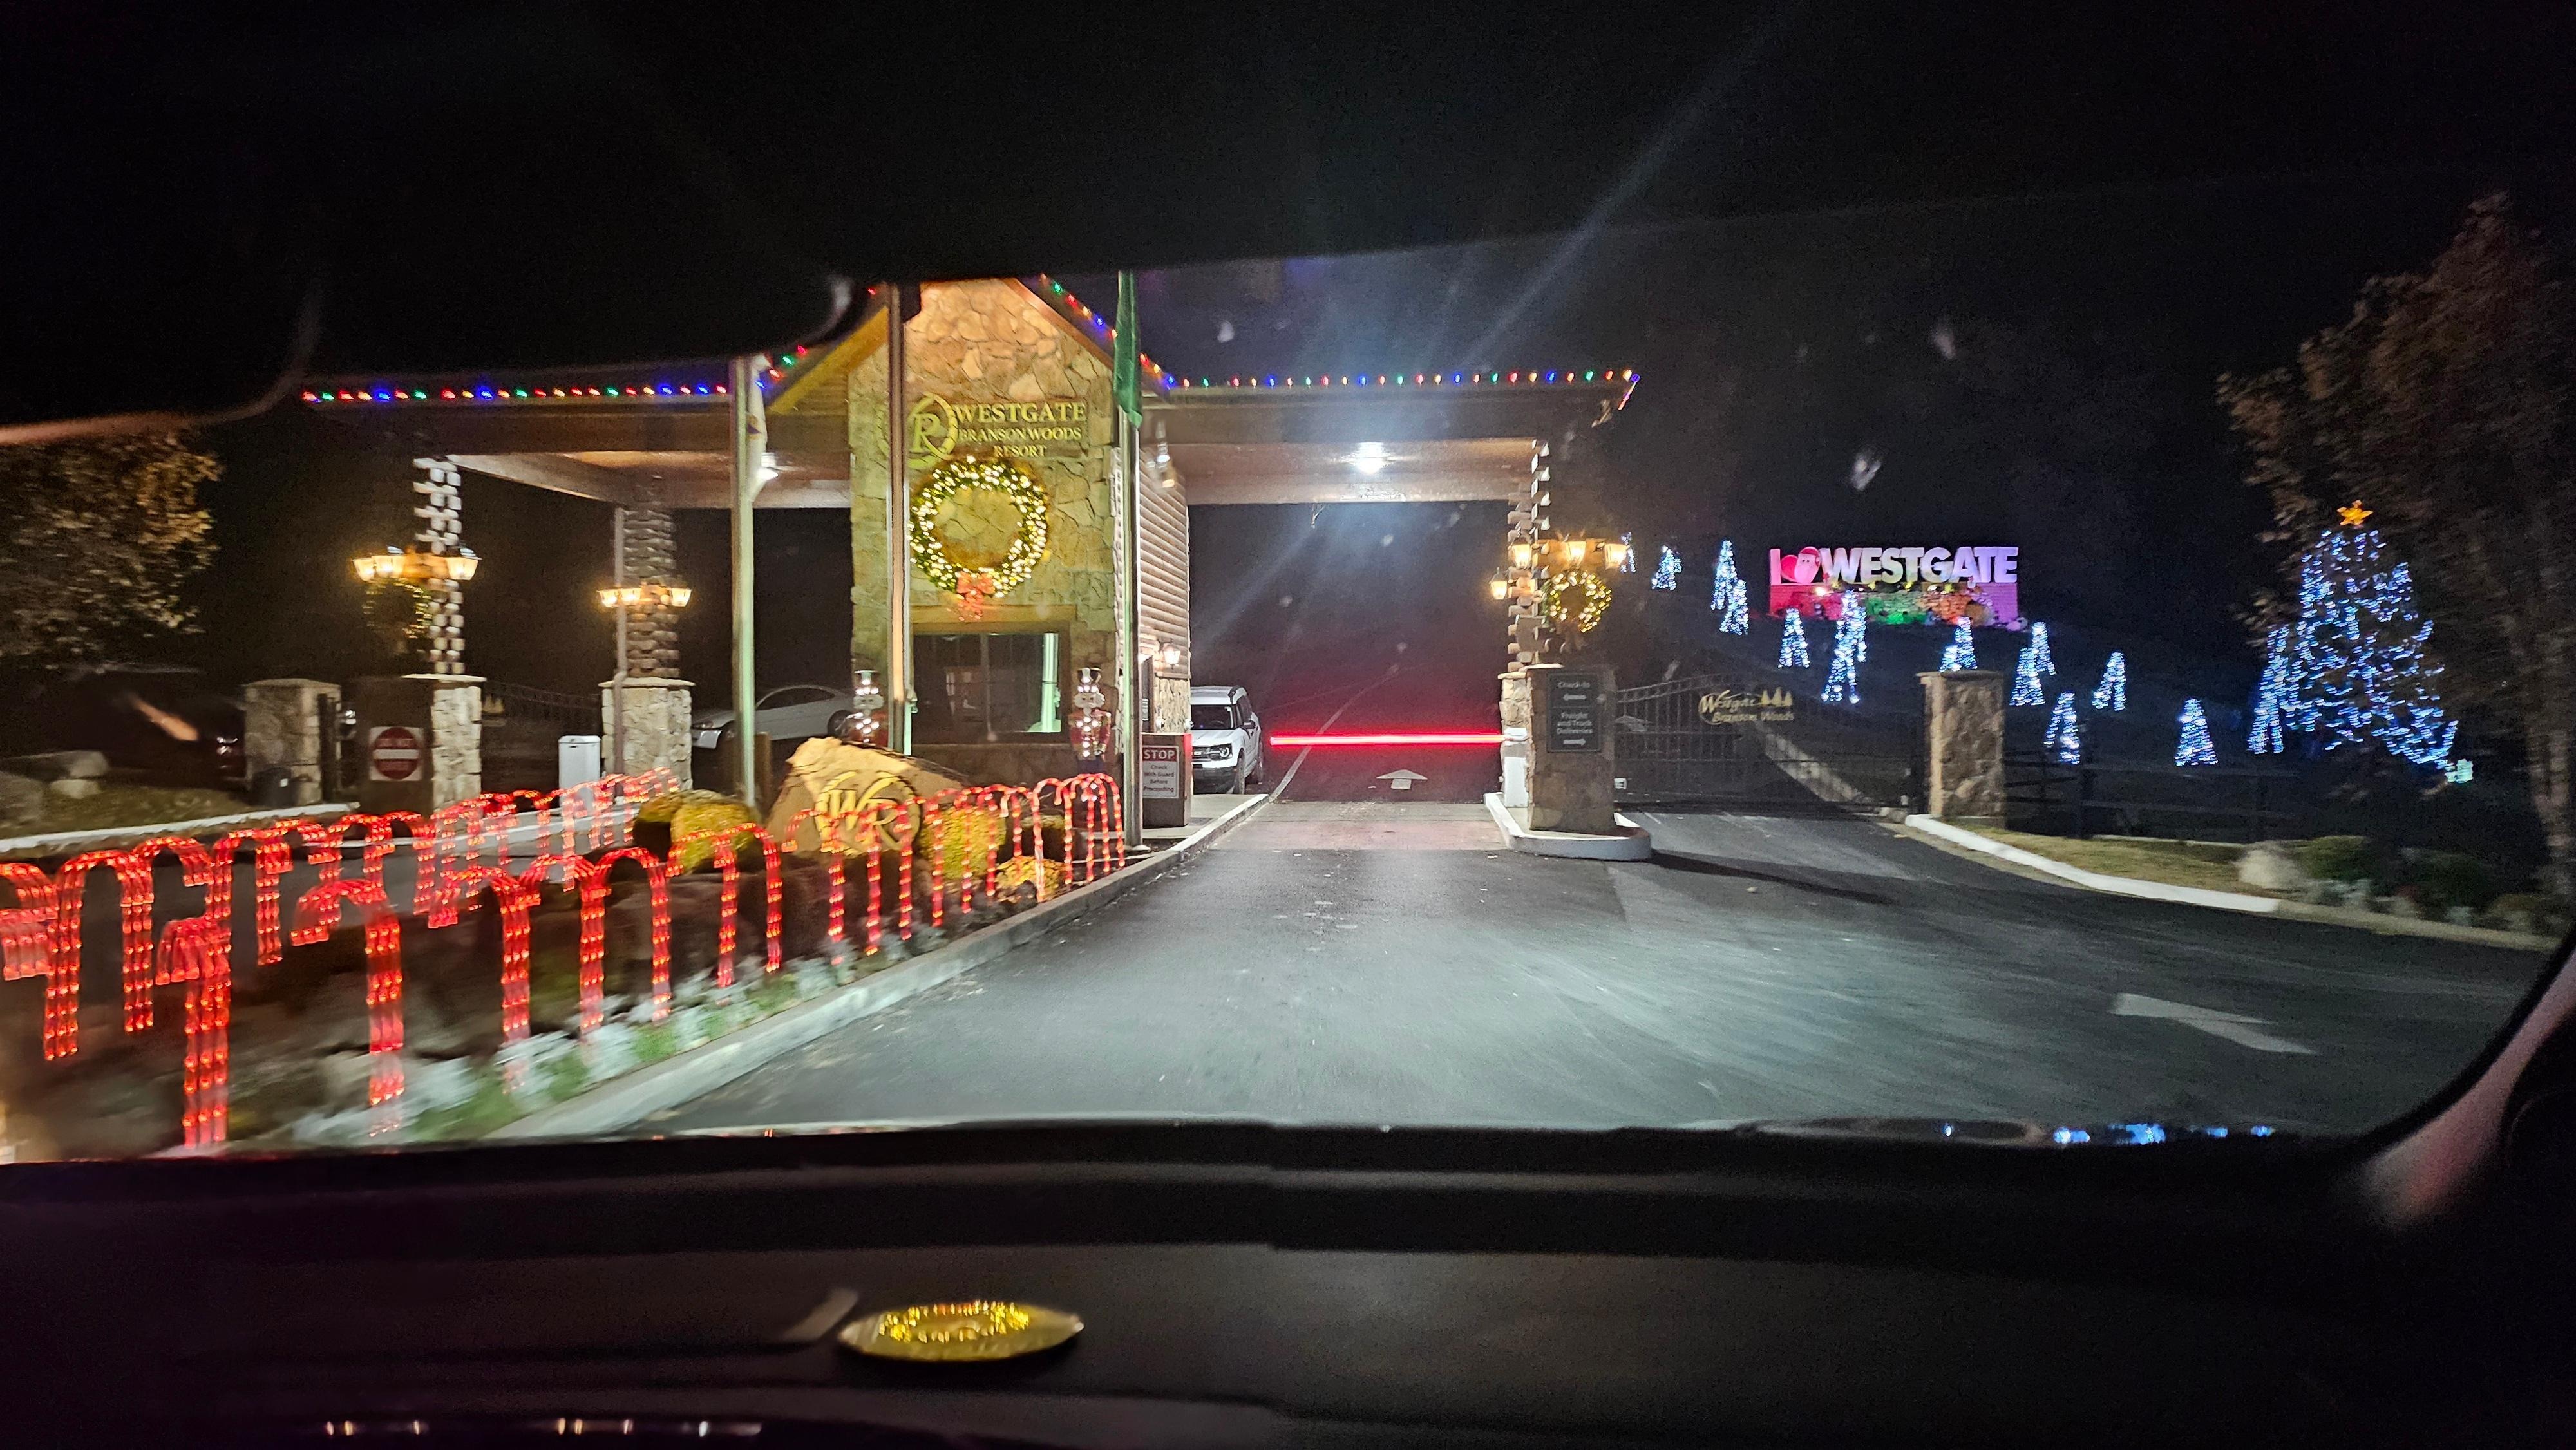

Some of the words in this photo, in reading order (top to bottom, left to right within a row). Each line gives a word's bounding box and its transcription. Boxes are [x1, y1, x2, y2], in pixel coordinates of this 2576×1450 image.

[953, 402, 1087, 423] WESTGATE
[958, 428, 1028, 442] BRANSON
[1027, 427, 1083, 441] WOODS
[994, 445, 1047, 458] RESORT
[1821, 546, 2019, 584] WESTGATE
[1143, 749, 1175, 759] STOP
